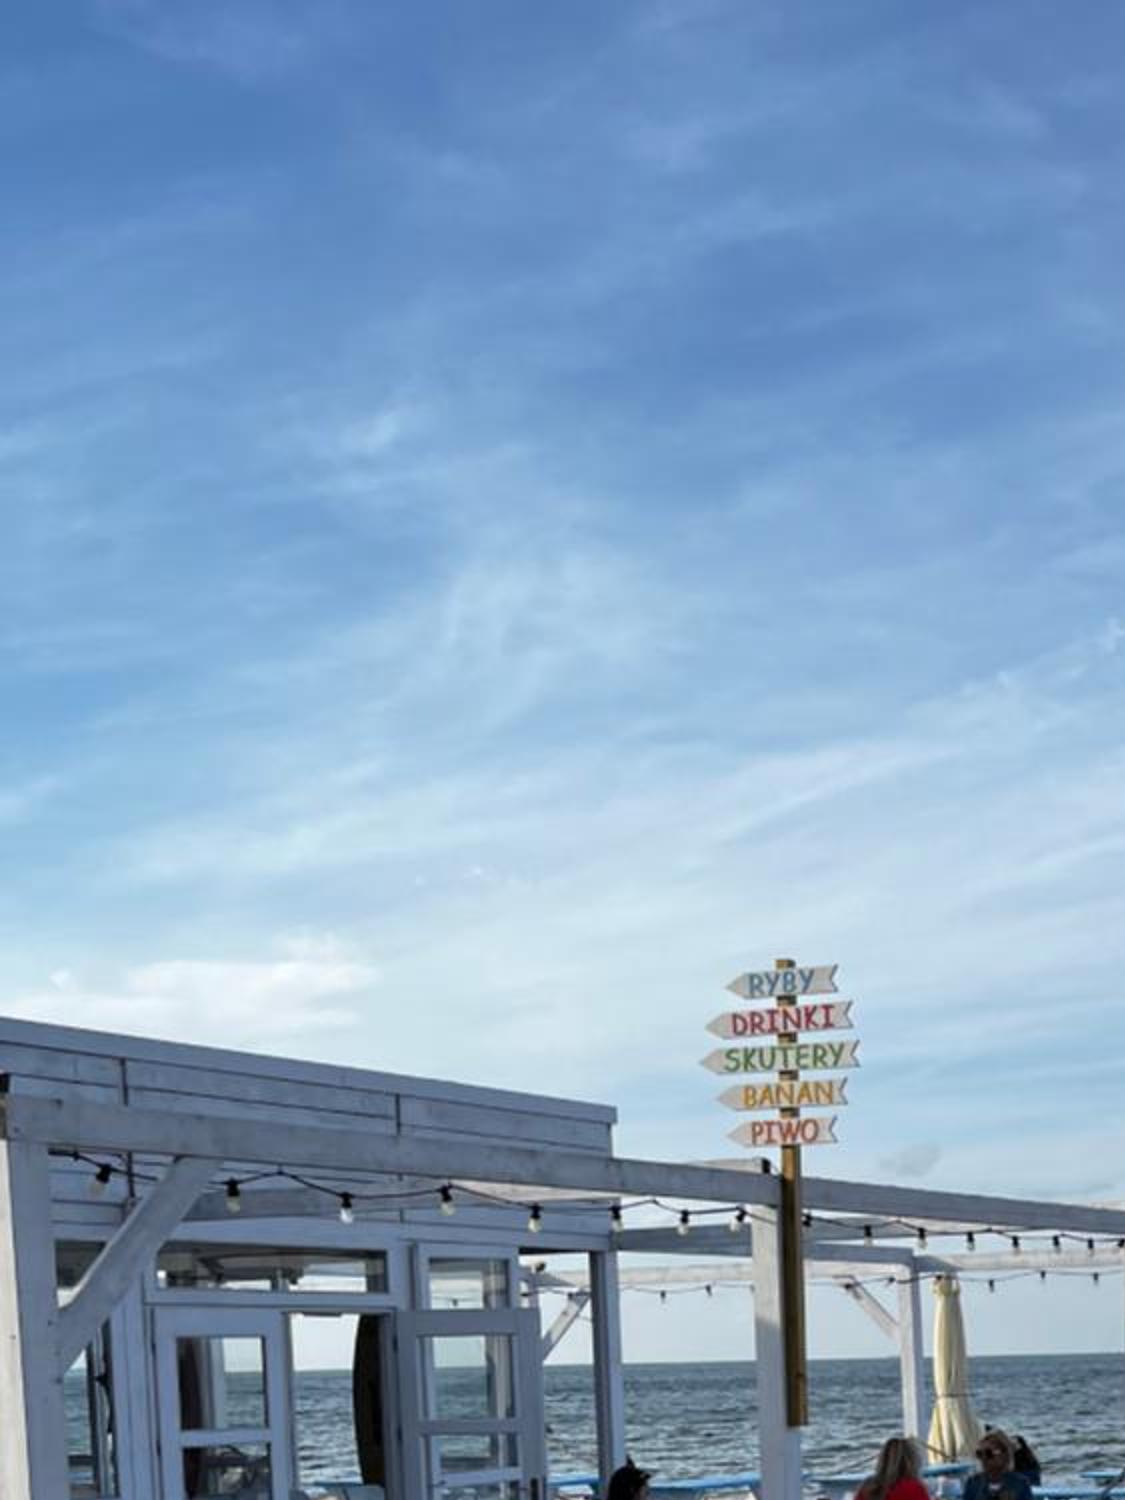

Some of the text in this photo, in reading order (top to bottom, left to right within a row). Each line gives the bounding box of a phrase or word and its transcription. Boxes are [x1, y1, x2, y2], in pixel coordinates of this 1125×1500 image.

[748, 970, 815, 998] RYBY
[731, 1004, 835, 1035] DRINKI
[724, 1042, 845, 1073] SKUTERY
[743, 1081, 833, 1107] BANAN
[751, 1118, 819, 1144] PIWO
